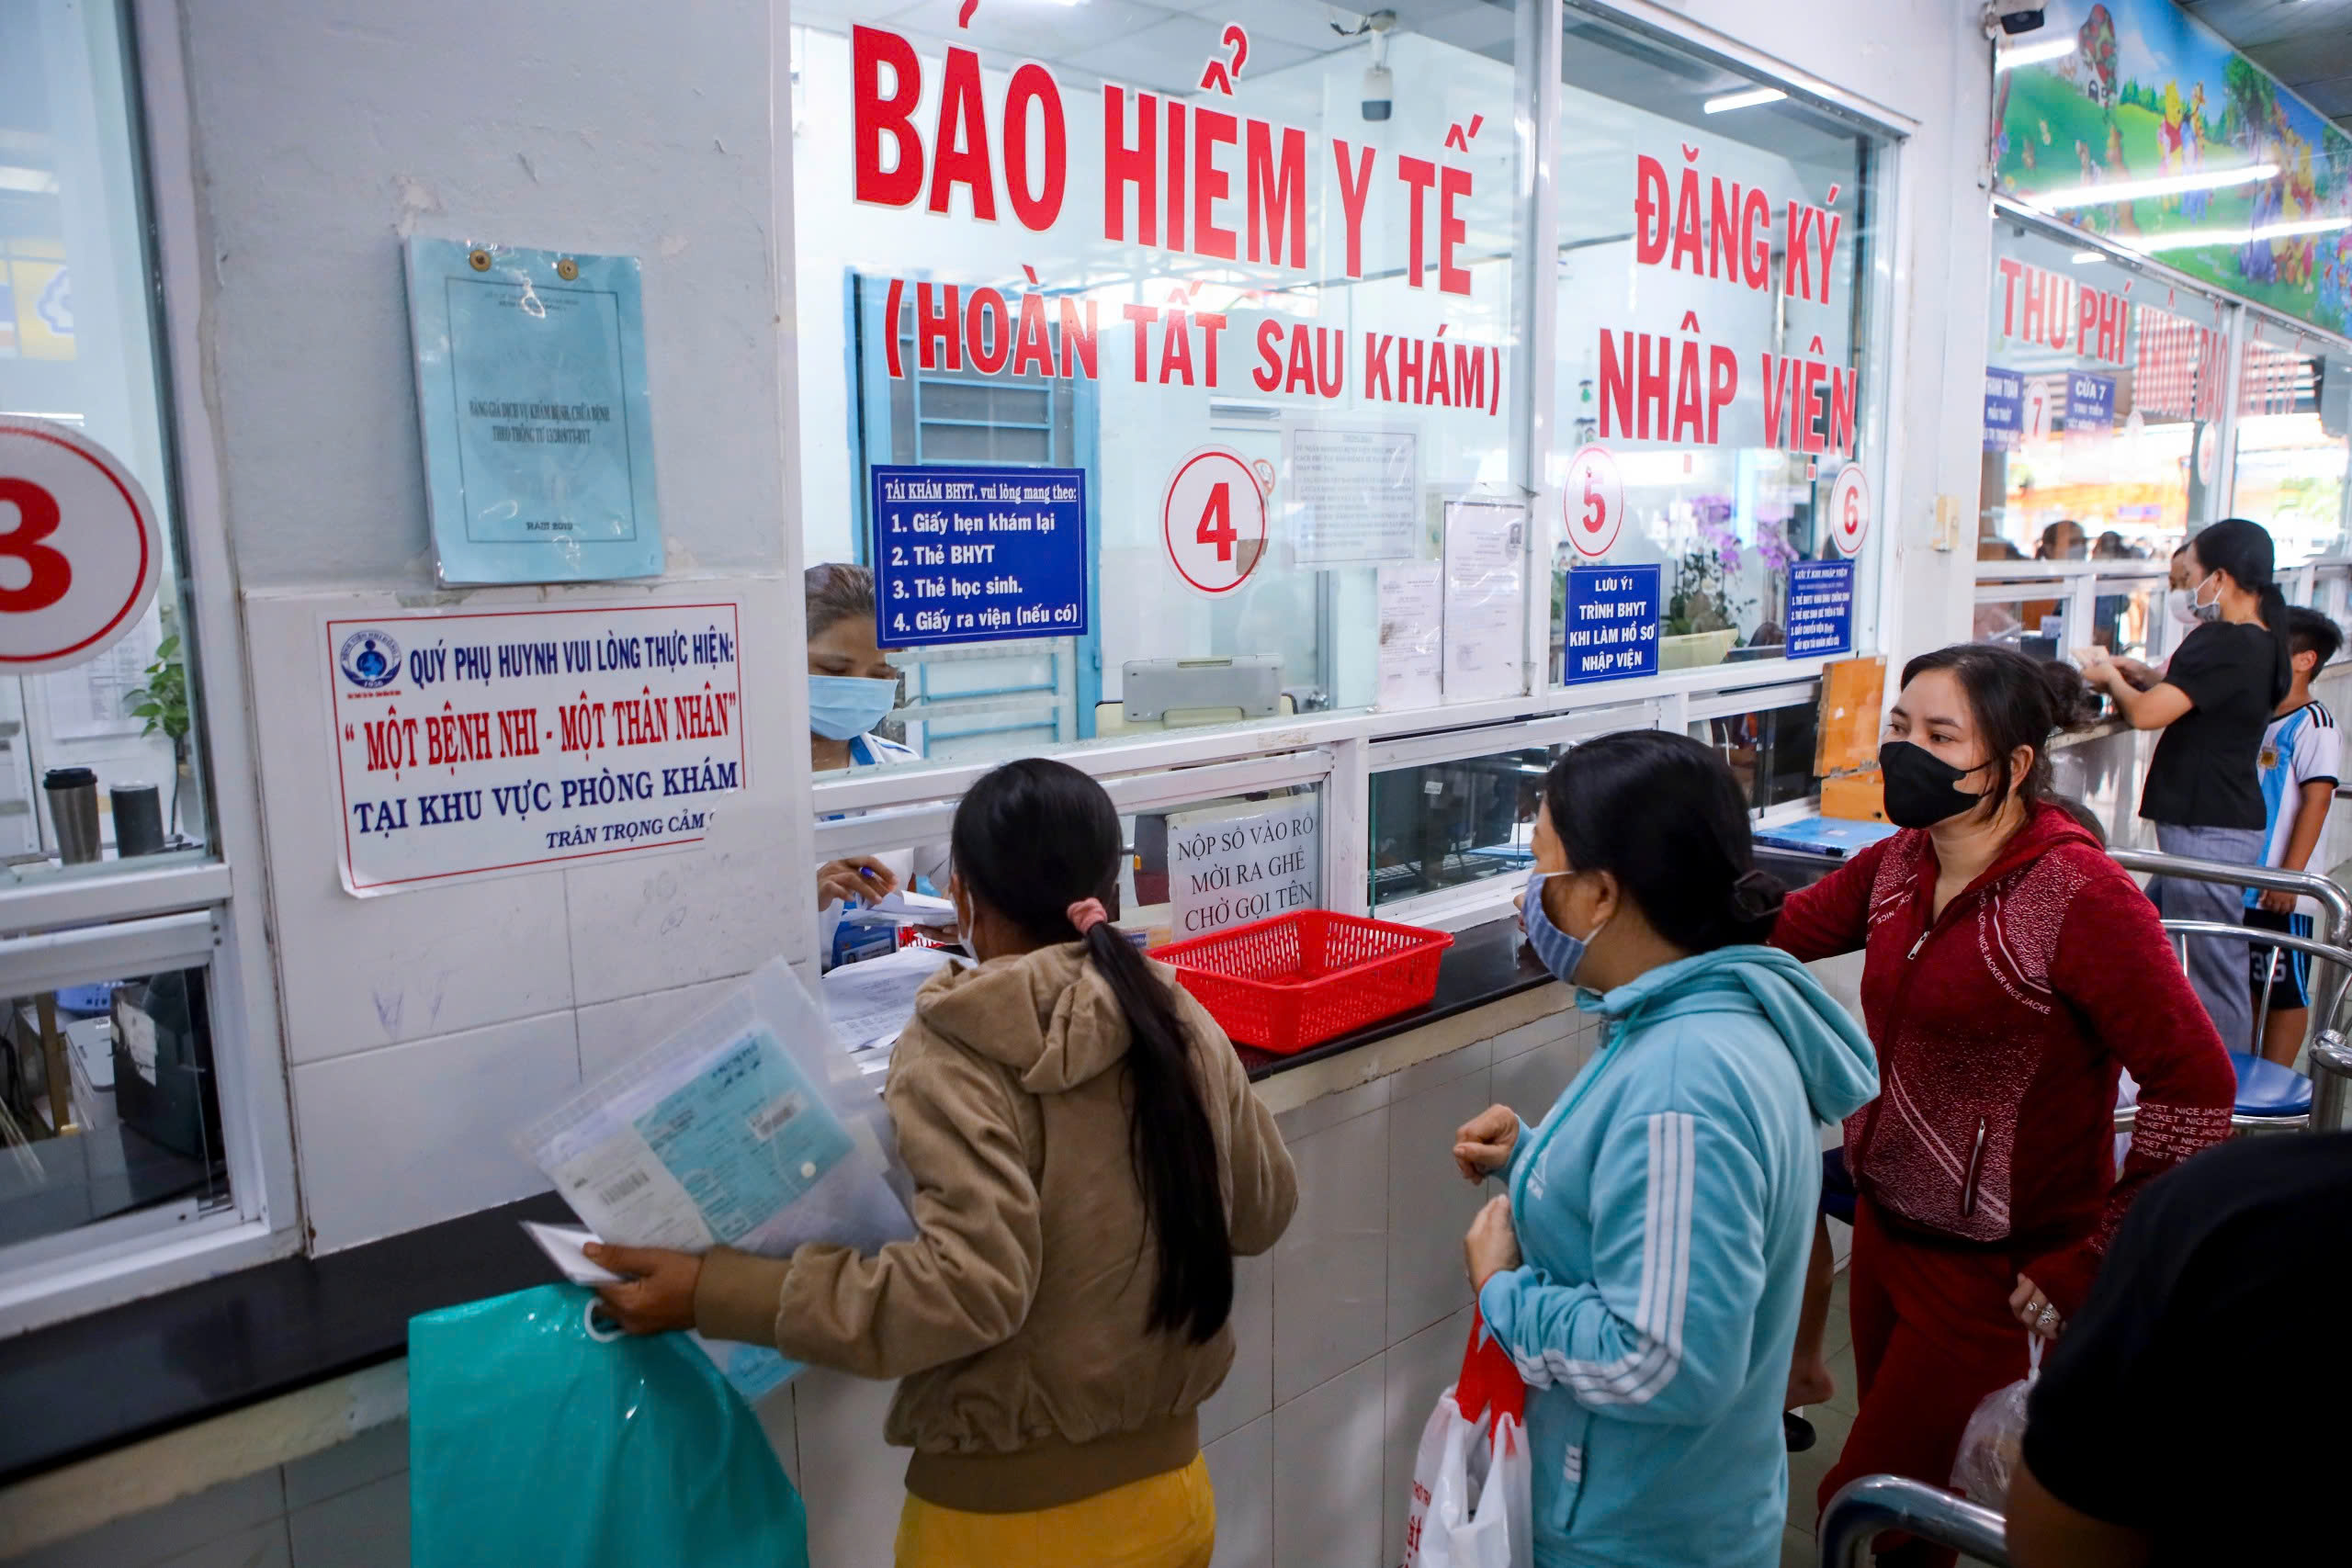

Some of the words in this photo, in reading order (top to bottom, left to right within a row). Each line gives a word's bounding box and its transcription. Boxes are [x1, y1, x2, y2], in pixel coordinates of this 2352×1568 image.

[1103, 24, 1306, 270] HIỂM
[1332, 139, 1375, 279] Y
[1398, 114, 1484, 297] TẾ
[1634, 142, 1771, 292] ĐĂNG
[1785, 185, 1841, 305] KÝ
[1999, 257, 2069, 350] THU
[2076, 280, 2132, 366] PHÍ
[885, 265, 1099, 380] (HOÀN
[1123, 281, 1227, 387] TẤT
[1252, 319, 1343, 399] SAU
[1365, 323, 1499, 415] KHÁM)
[1600, 310, 1738, 473] NHẬP
[1762, 336, 1857, 480] VIỆN
[2099, 385, 2107, 400] 7
[2033, 397, 2042, 437] 7
[886, 479, 906, 500] TÁI
[908, 479, 943, 500] KHÁM
[945, 483, 978, 502] BHYT,
[980, 484, 998, 500] vui
[1000, 482, 1022, 504] lòng
[1023, 485, 1050, 504] mang
[1053, 484, 1077, 500] theo:
[1582, 467, 1606, 534] 5
[1844, 485, 1859, 536] 6
[891, 513, 908, 533] 1.
[912, 512, 948, 536] Giấy
[954, 513, 984, 536] hẹn
[989, 513, 1032, 532] khám
[1036, 513, 1055, 535] lại
[1195, 482, 1238, 561] 4
[891, 547, 909, 567] 2.
[913, 544, 945, 566] Thẻ
[951, 544, 995, 564] BHYT
[892, 581, 910, 599] 3.
[914, 577, 945, 598] Thẻ
[952, 578, 981, 599] học
[986, 576, 1023, 595] sinh.
[1595, 577, 1617, 592] LƯU
[1621, 575, 1633, 591] Ý!
[893, 613, 910, 632] 4.
[915, 609, 951, 632] Giấy
[956, 613, 974, 627] ra
[979, 607, 1011, 629] viện
[1016, 604, 1049, 626] (nếu
[1055, 603, 1078, 623] có)
[1578, 600, 1614, 620] TRÌNH
[1617, 601, 1646, 618] BHYT
[1569, 630, 1590, 648] KHI
[1593, 625, 1619, 645] LÀM
[1621, 621, 1637, 643] HỒ
[1640, 623, 1656, 641] SƠ
[410, 638, 447, 690] QUÝ
[455, 646, 492, 686] PHỤ
[498, 642, 558, 678] HUYNH
[563, 640, 592, 673] VUI
[597, 629, 640, 671] LÒNG
[645, 629, 688, 672] THỰC
[693, 625, 734, 670] HIỆN:
[1582, 650, 1614, 672] NHẬP
[1617, 648, 1643, 670] VIỆN
[364, 705, 418, 782] MỘT
[425, 700, 492, 776] BỆNH
[497, 708, 539, 758] NHI
[559, 690, 605, 761] MỘT
[613, 685, 668, 747] THÂN
[354, 798, 409, 838] TẠI
[419, 790, 483, 827] KHU
[492, 779, 552, 822] VỰC
[560, 772, 654, 809] PHÒNG
[662, 757, 739, 798] KHÁM
[547, 825, 597, 850] TRÂN
[603, 818, 663, 844] TRỌNG
[668, 809, 705, 832] CẢM
[1178, 833, 1216, 862] NỘP
[1250, 819, 1287, 845] VÀO
[1191, 863, 1230, 895] MỜI
[1236, 862, 1263, 886] RA
[1269, 845, 1306, 877] GHẾ
[1185, 897, 1229, 931] CHỜ
[1235, 892, 1271, 919] GỌI
[1276, 880, 1313, 908] TÊN
[1978, 932, 1990, 953] NICE
[2003, 982, 2023, 1000] NICE
[2171, 1125, 2197, 1135] NICE
[2175, 1107, 2200, 1116] NICE
[2185, 1117, 2210, 1126] NICE
[2139, 1128, 2176, 1142] JACKET
[2180, 1137, 2205, 1147] NICE
[2167, 1145, 2193, 1156] NICE
